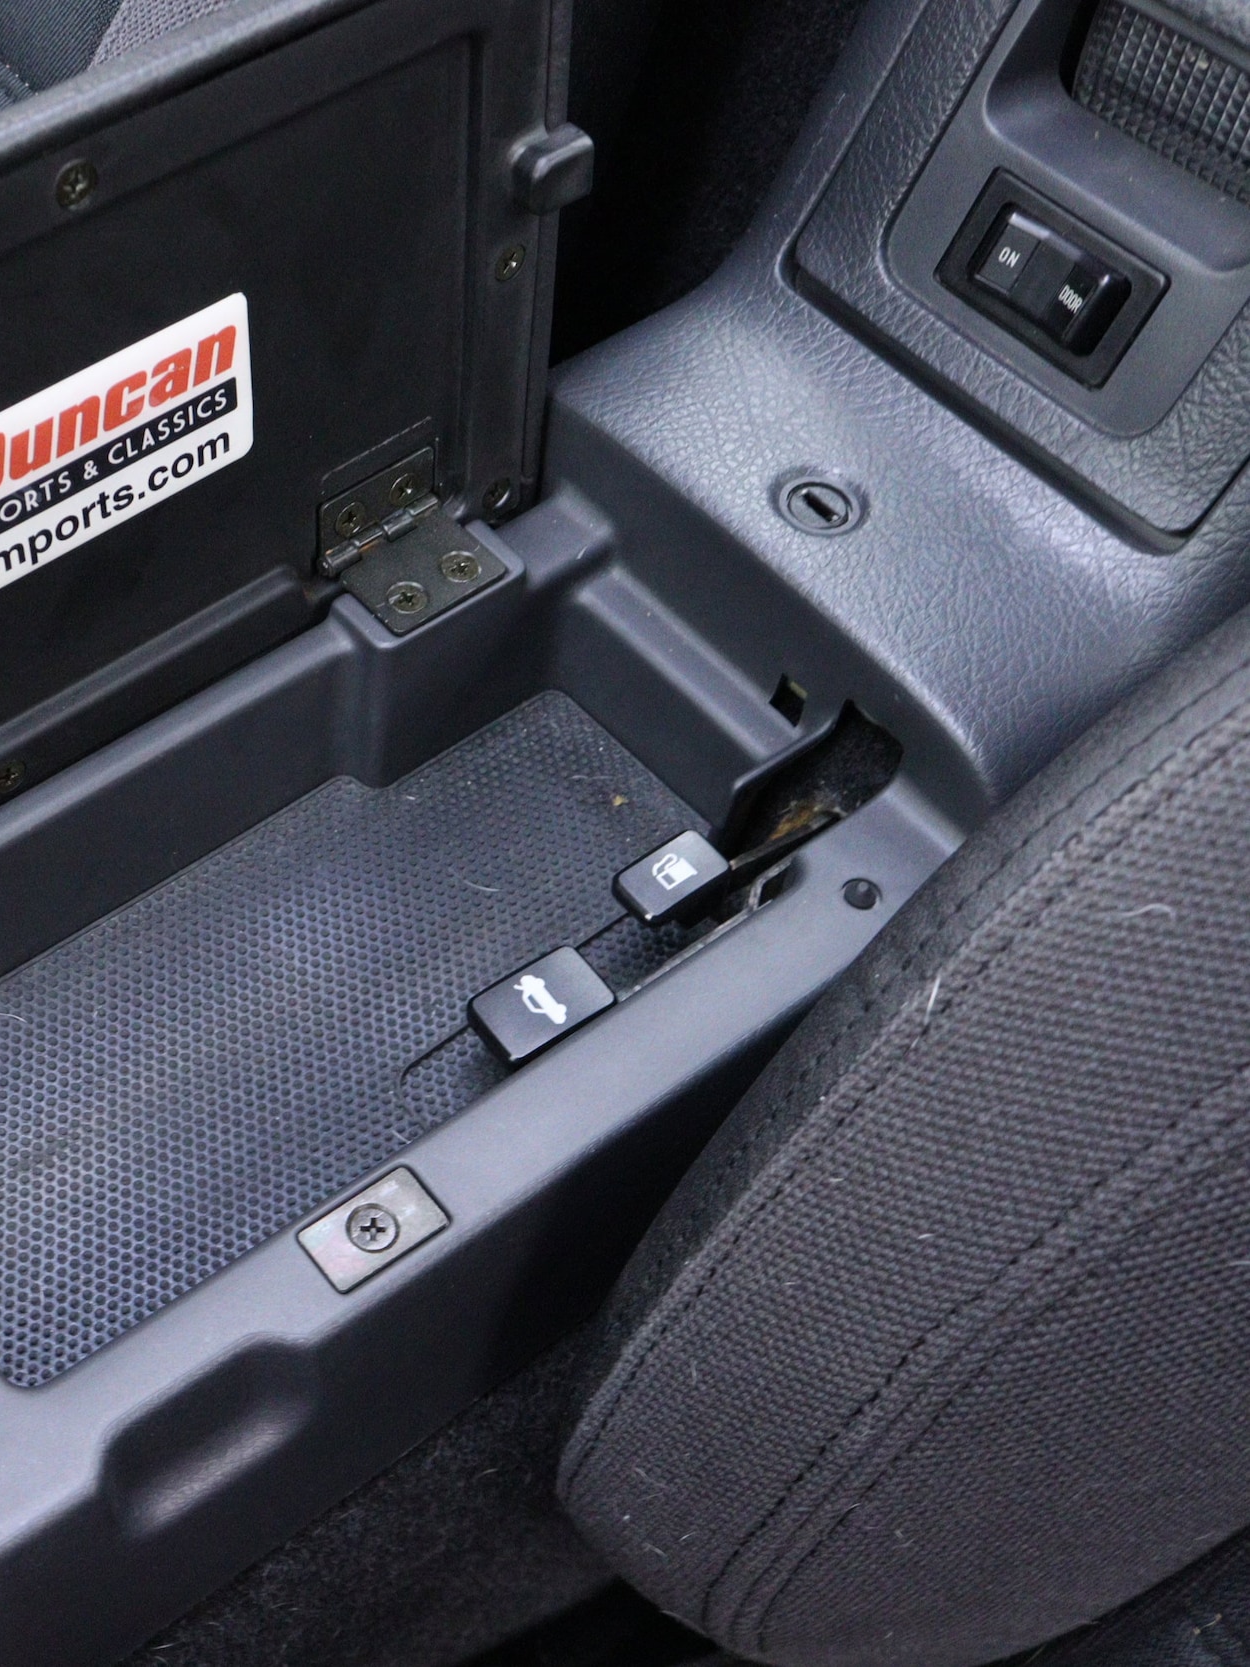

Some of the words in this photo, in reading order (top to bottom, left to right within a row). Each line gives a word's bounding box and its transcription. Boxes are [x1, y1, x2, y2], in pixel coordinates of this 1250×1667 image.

[998, 246, 1021, 268] ON
[1058, 284, 1083, 314] DOOR
[82, 459, 99, 481] &
[108, 388, 228, 466] CLASSICS
